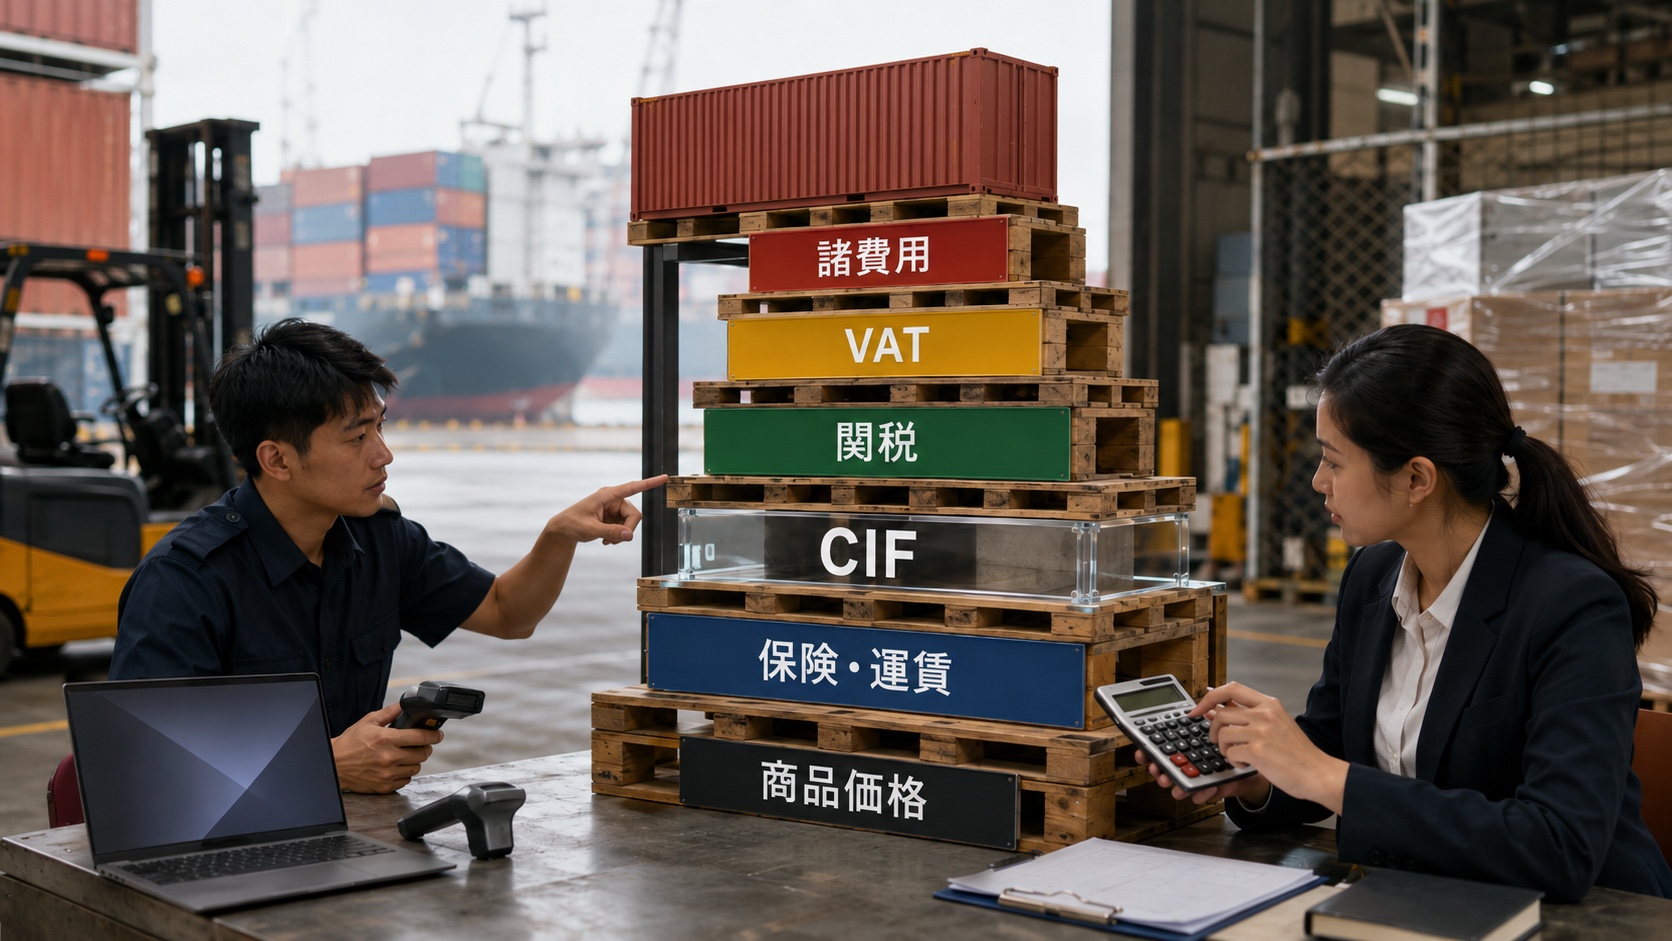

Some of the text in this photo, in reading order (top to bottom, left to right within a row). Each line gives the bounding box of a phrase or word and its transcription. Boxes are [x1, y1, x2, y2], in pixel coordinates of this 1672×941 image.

[817, 236, 930, 278] 諸費用
[844, 326, 930, 363] VAT
[837, 421, 918, 463] 関税
[820, 527, 917, 579] CIF
[758, 638, 952, 697] 保険・運賃
[761, 759, 927, 821] 商品価格
